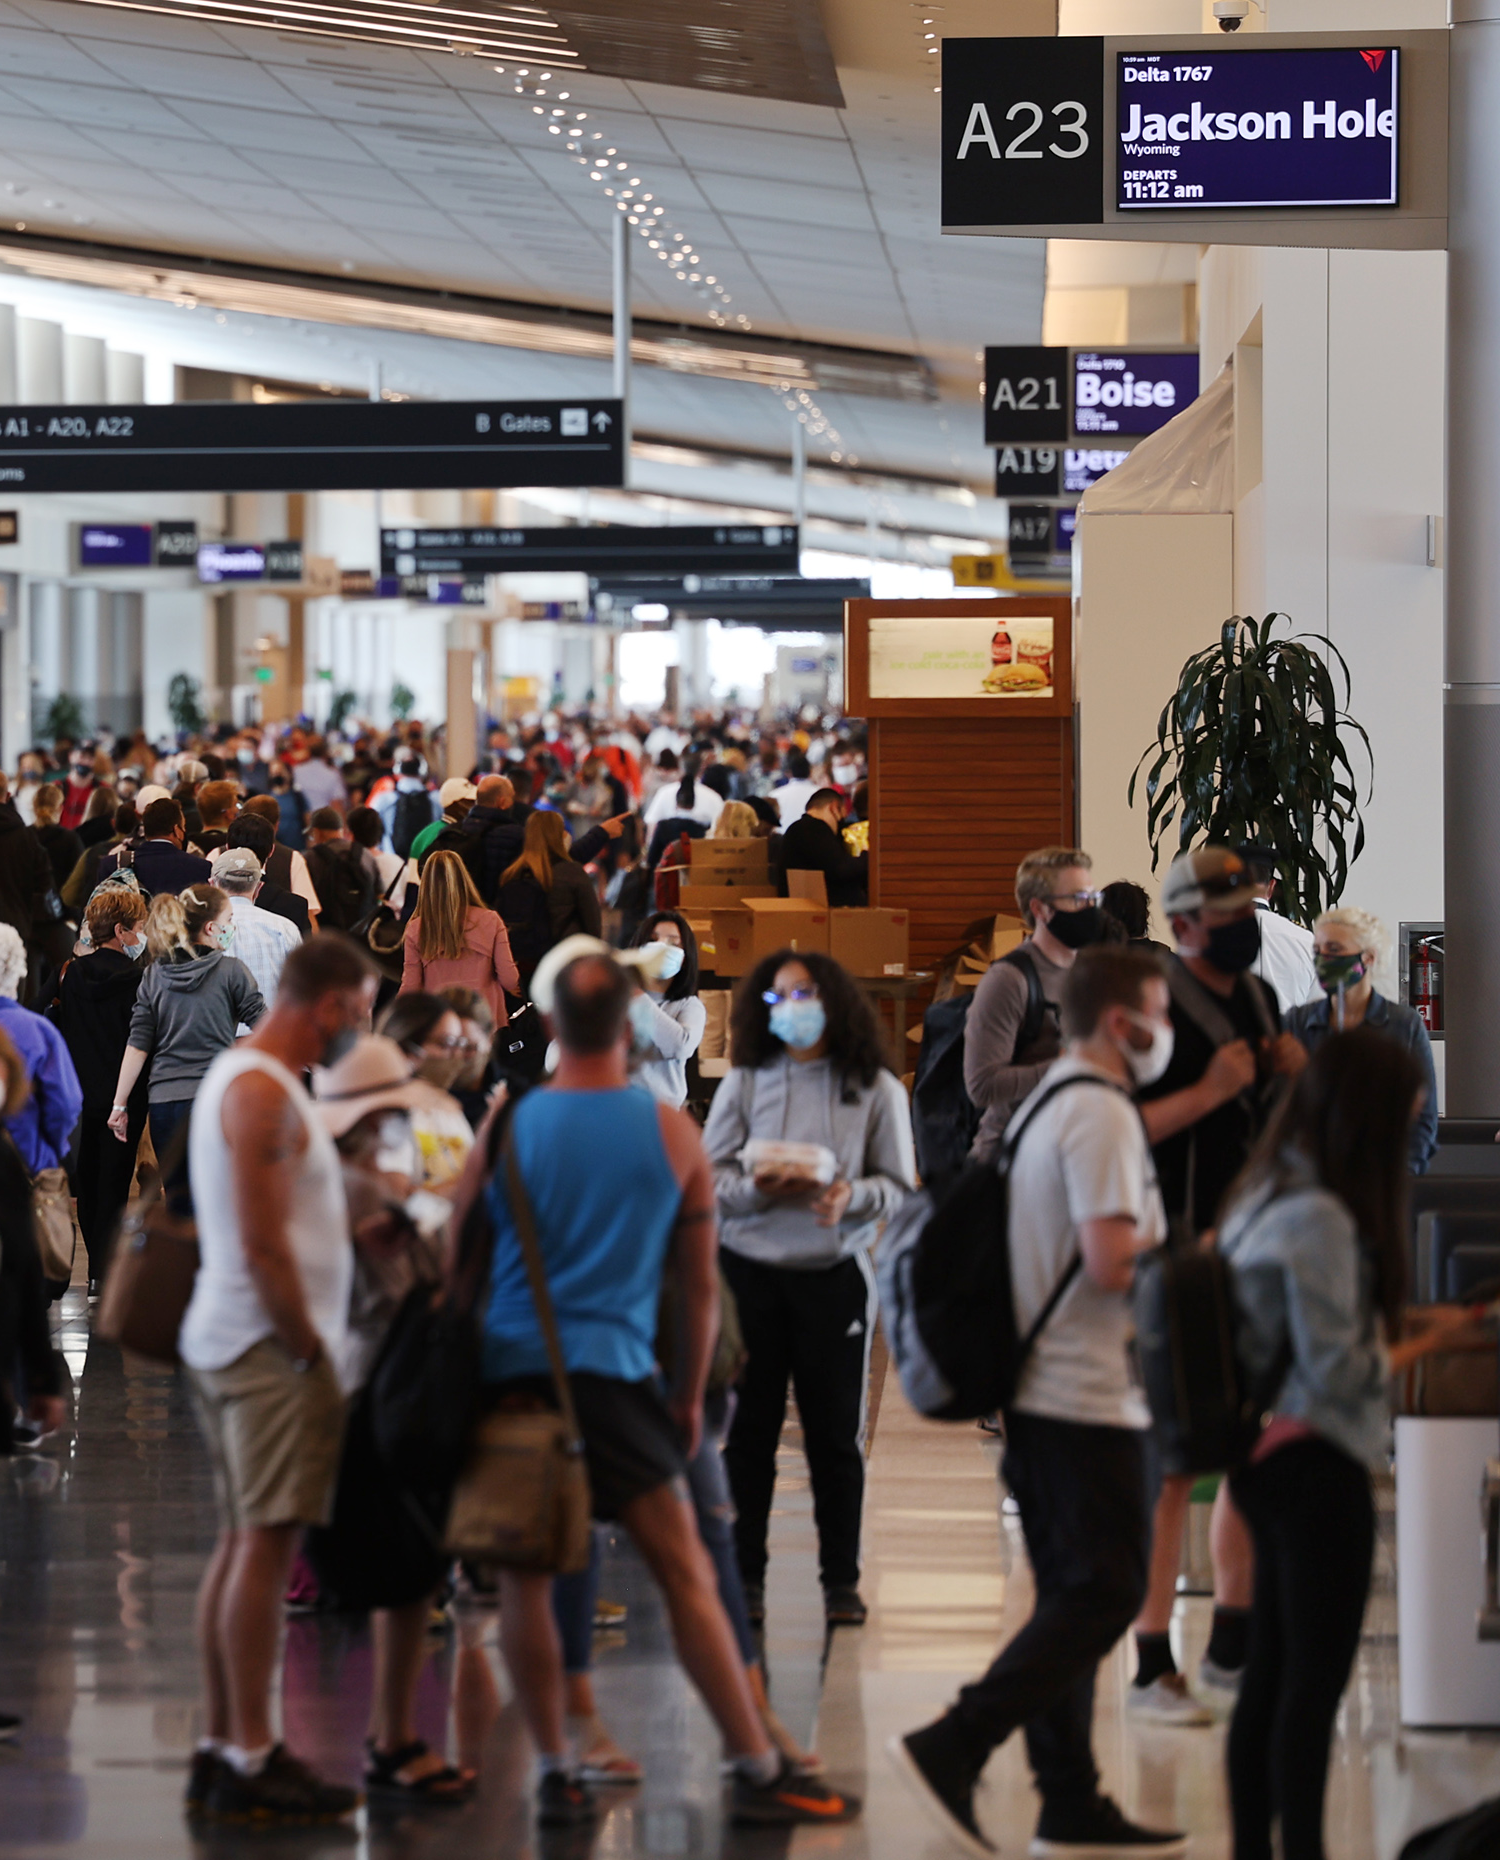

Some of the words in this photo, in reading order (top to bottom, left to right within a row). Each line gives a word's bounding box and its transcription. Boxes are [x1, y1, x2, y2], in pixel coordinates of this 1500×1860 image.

[1124, 66, 1170, 82] Delta
[1173, 66, 1213, 82] 1767
[956, 101, 1089, 159] A23
[1120, 101, 1292, 142] Jackson
[1123, 143, 1181, 158] Wyoming
[1123, 169, 1178, 181] DEPARTS
[1123, 181, 1170, 199] 11:12
[1174, 184, 1204, 198] am
[992, 377, 1061, 411] A21
[1076, 371, 1176, 408] Boise
[5, 417, 30, 437] A1
[95, 417, 134, 437] A22
[475, 412, 491, 433] B
[500, 412, 552, 433] Gates
[998, 447, 1056, 474] A19
[1009, 517, 1050, 541] A17
